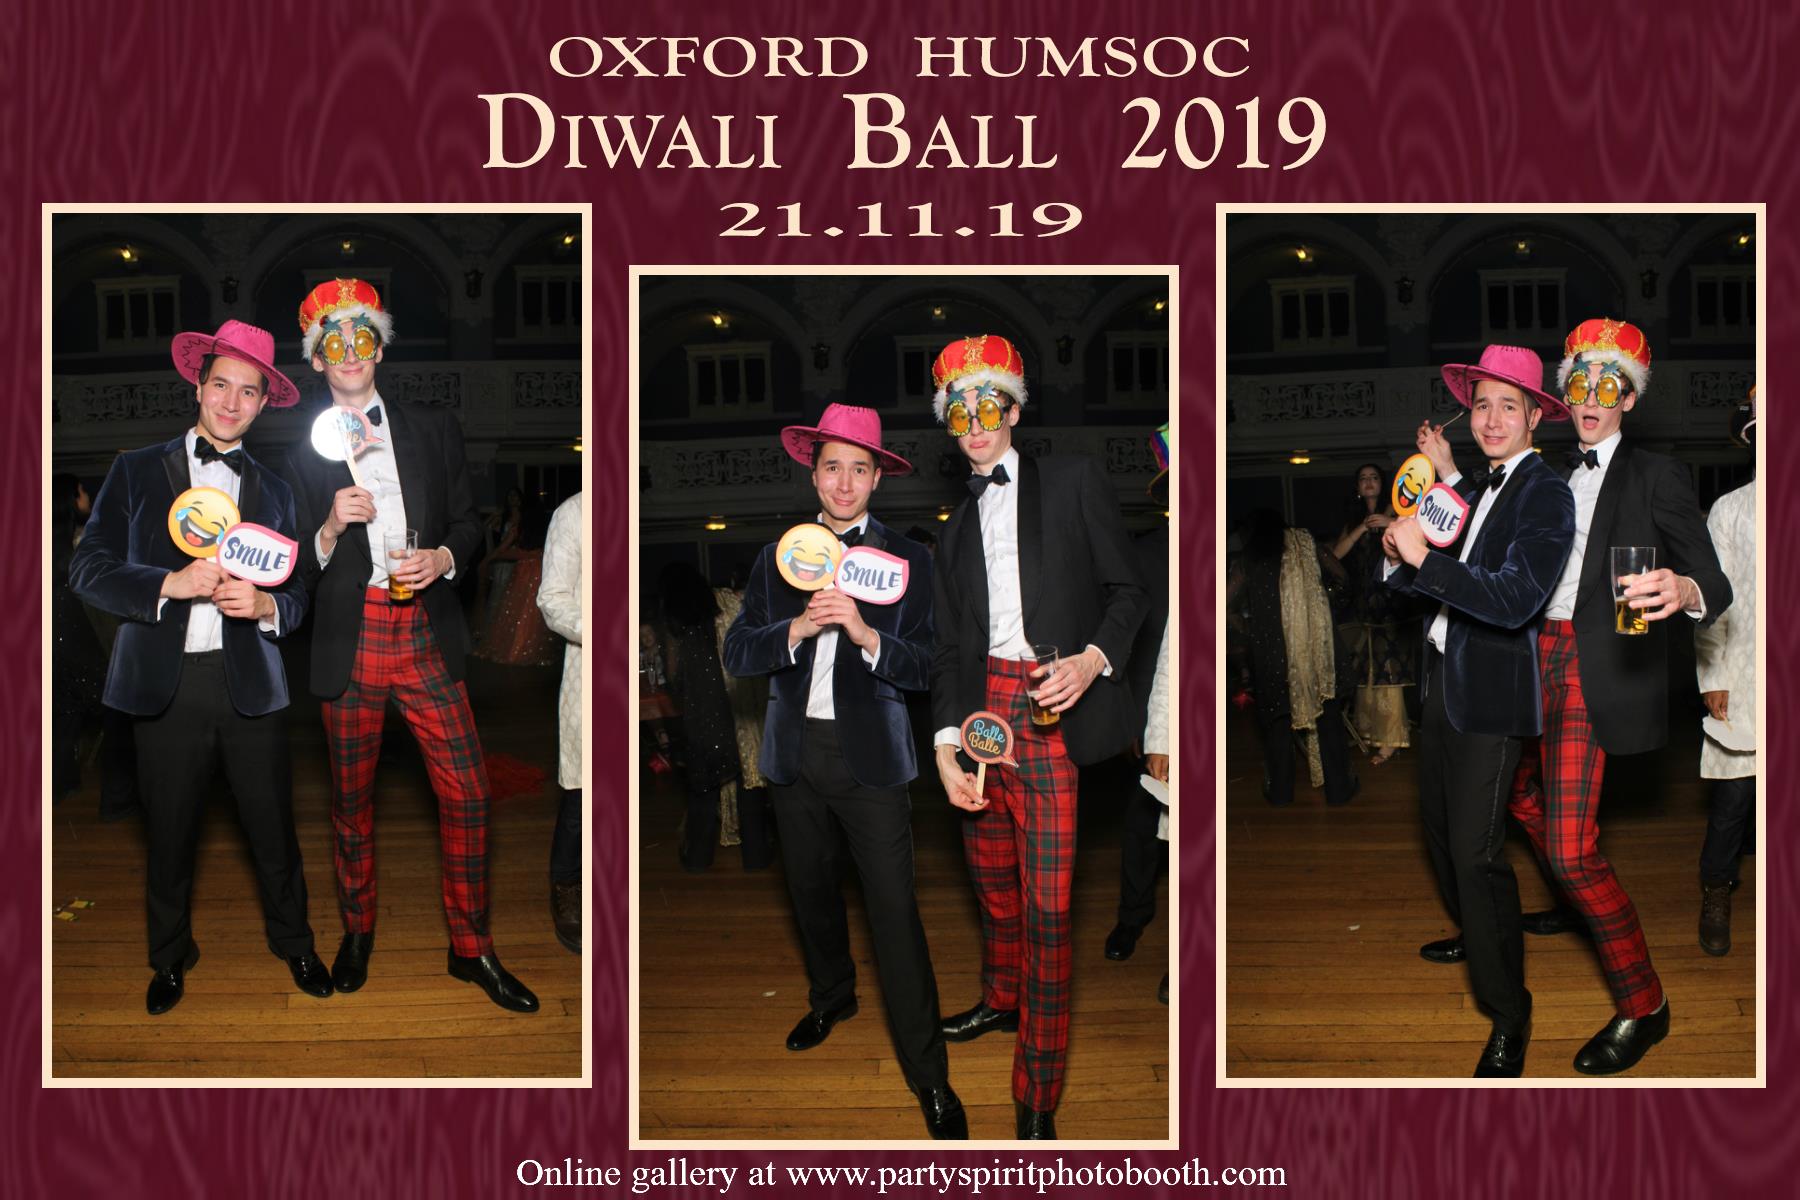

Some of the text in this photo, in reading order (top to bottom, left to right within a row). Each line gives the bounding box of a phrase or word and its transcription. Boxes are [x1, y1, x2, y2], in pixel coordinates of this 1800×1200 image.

[1420, 495, 1460, 532] SMILE
[224, 536, 289, 572] SMILE
[842, 560, 902, 591] SMILE
[969, 732, 1001, 755] Balle
[974, 720, 1005, 743] Balle
